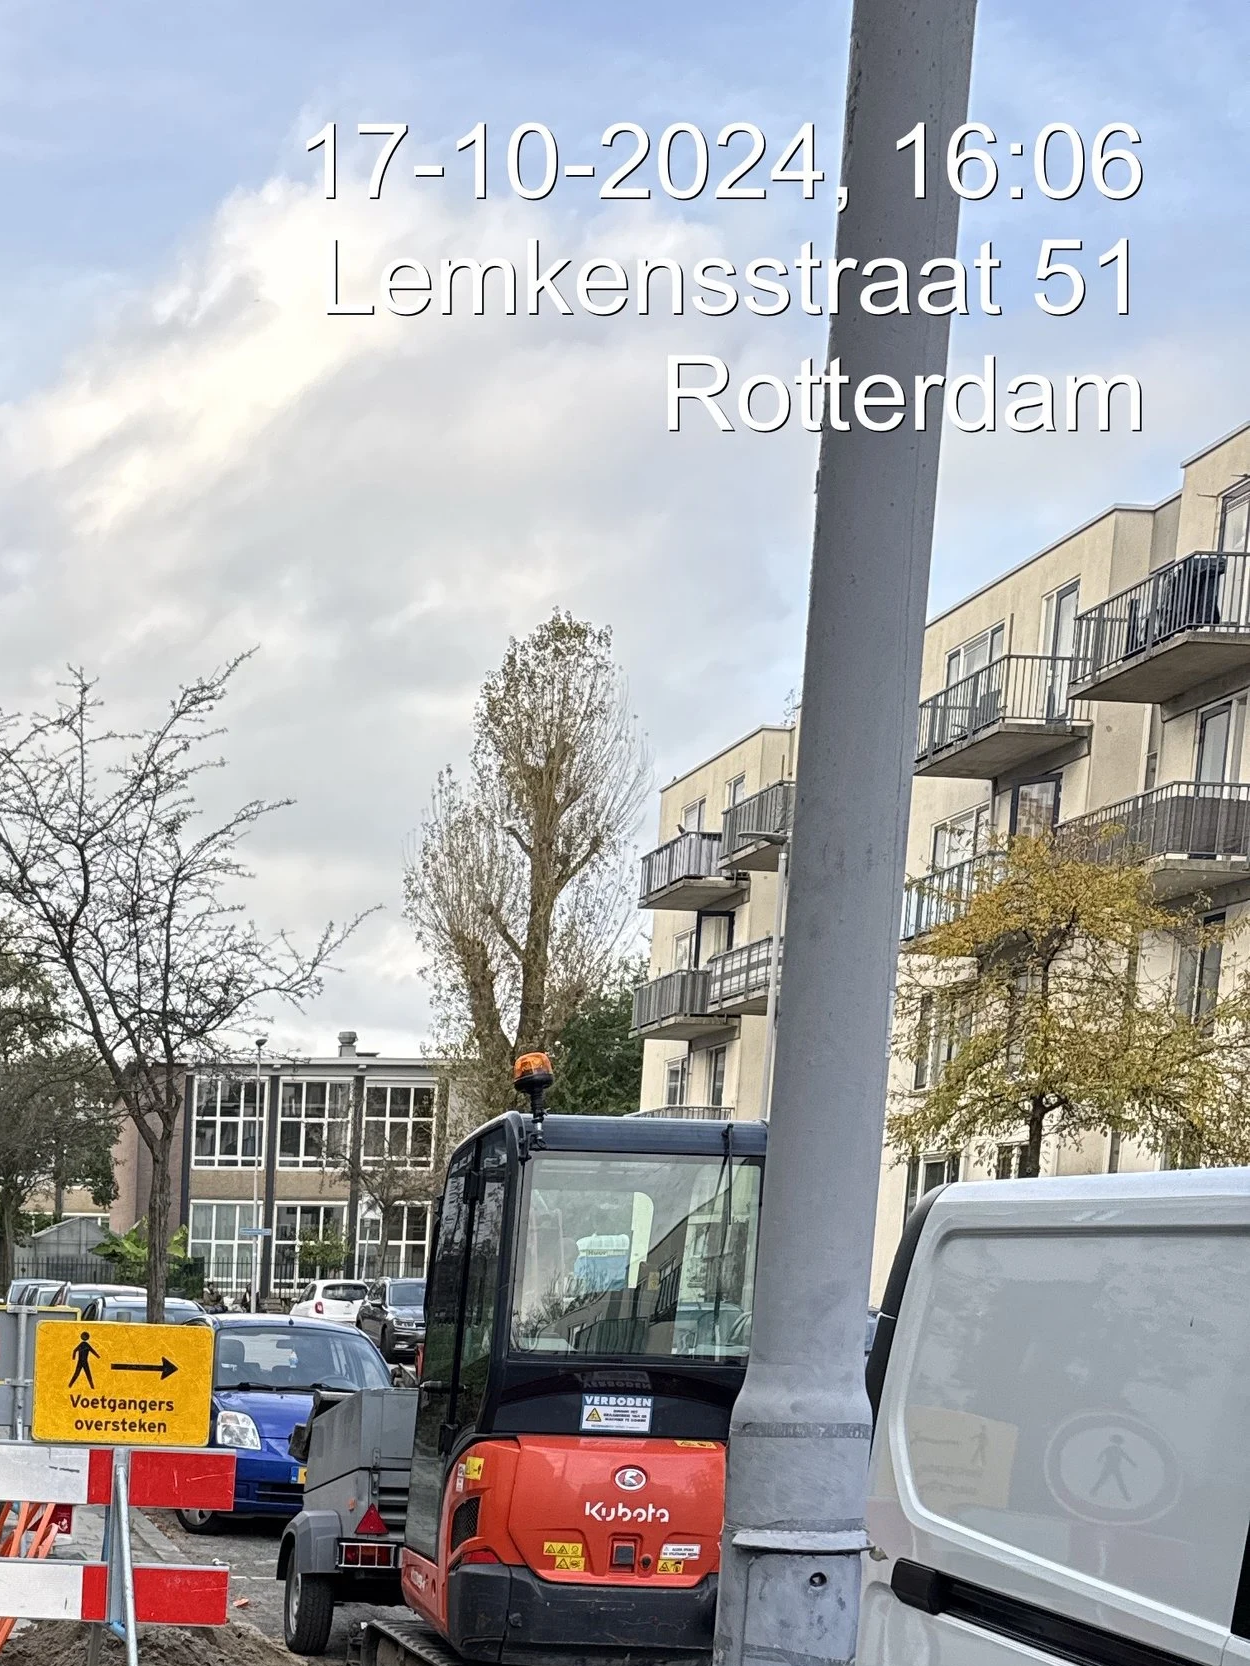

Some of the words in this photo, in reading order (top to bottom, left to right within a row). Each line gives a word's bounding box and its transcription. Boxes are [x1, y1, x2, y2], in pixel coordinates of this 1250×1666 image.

[70, 1394, 174, 1414] Voetgangers
[584, 1395, 652, 1407] VERBODEN
[74, 1418, 167, 1433] oversteken
[584, 1501, 670, 1523] Kubota
